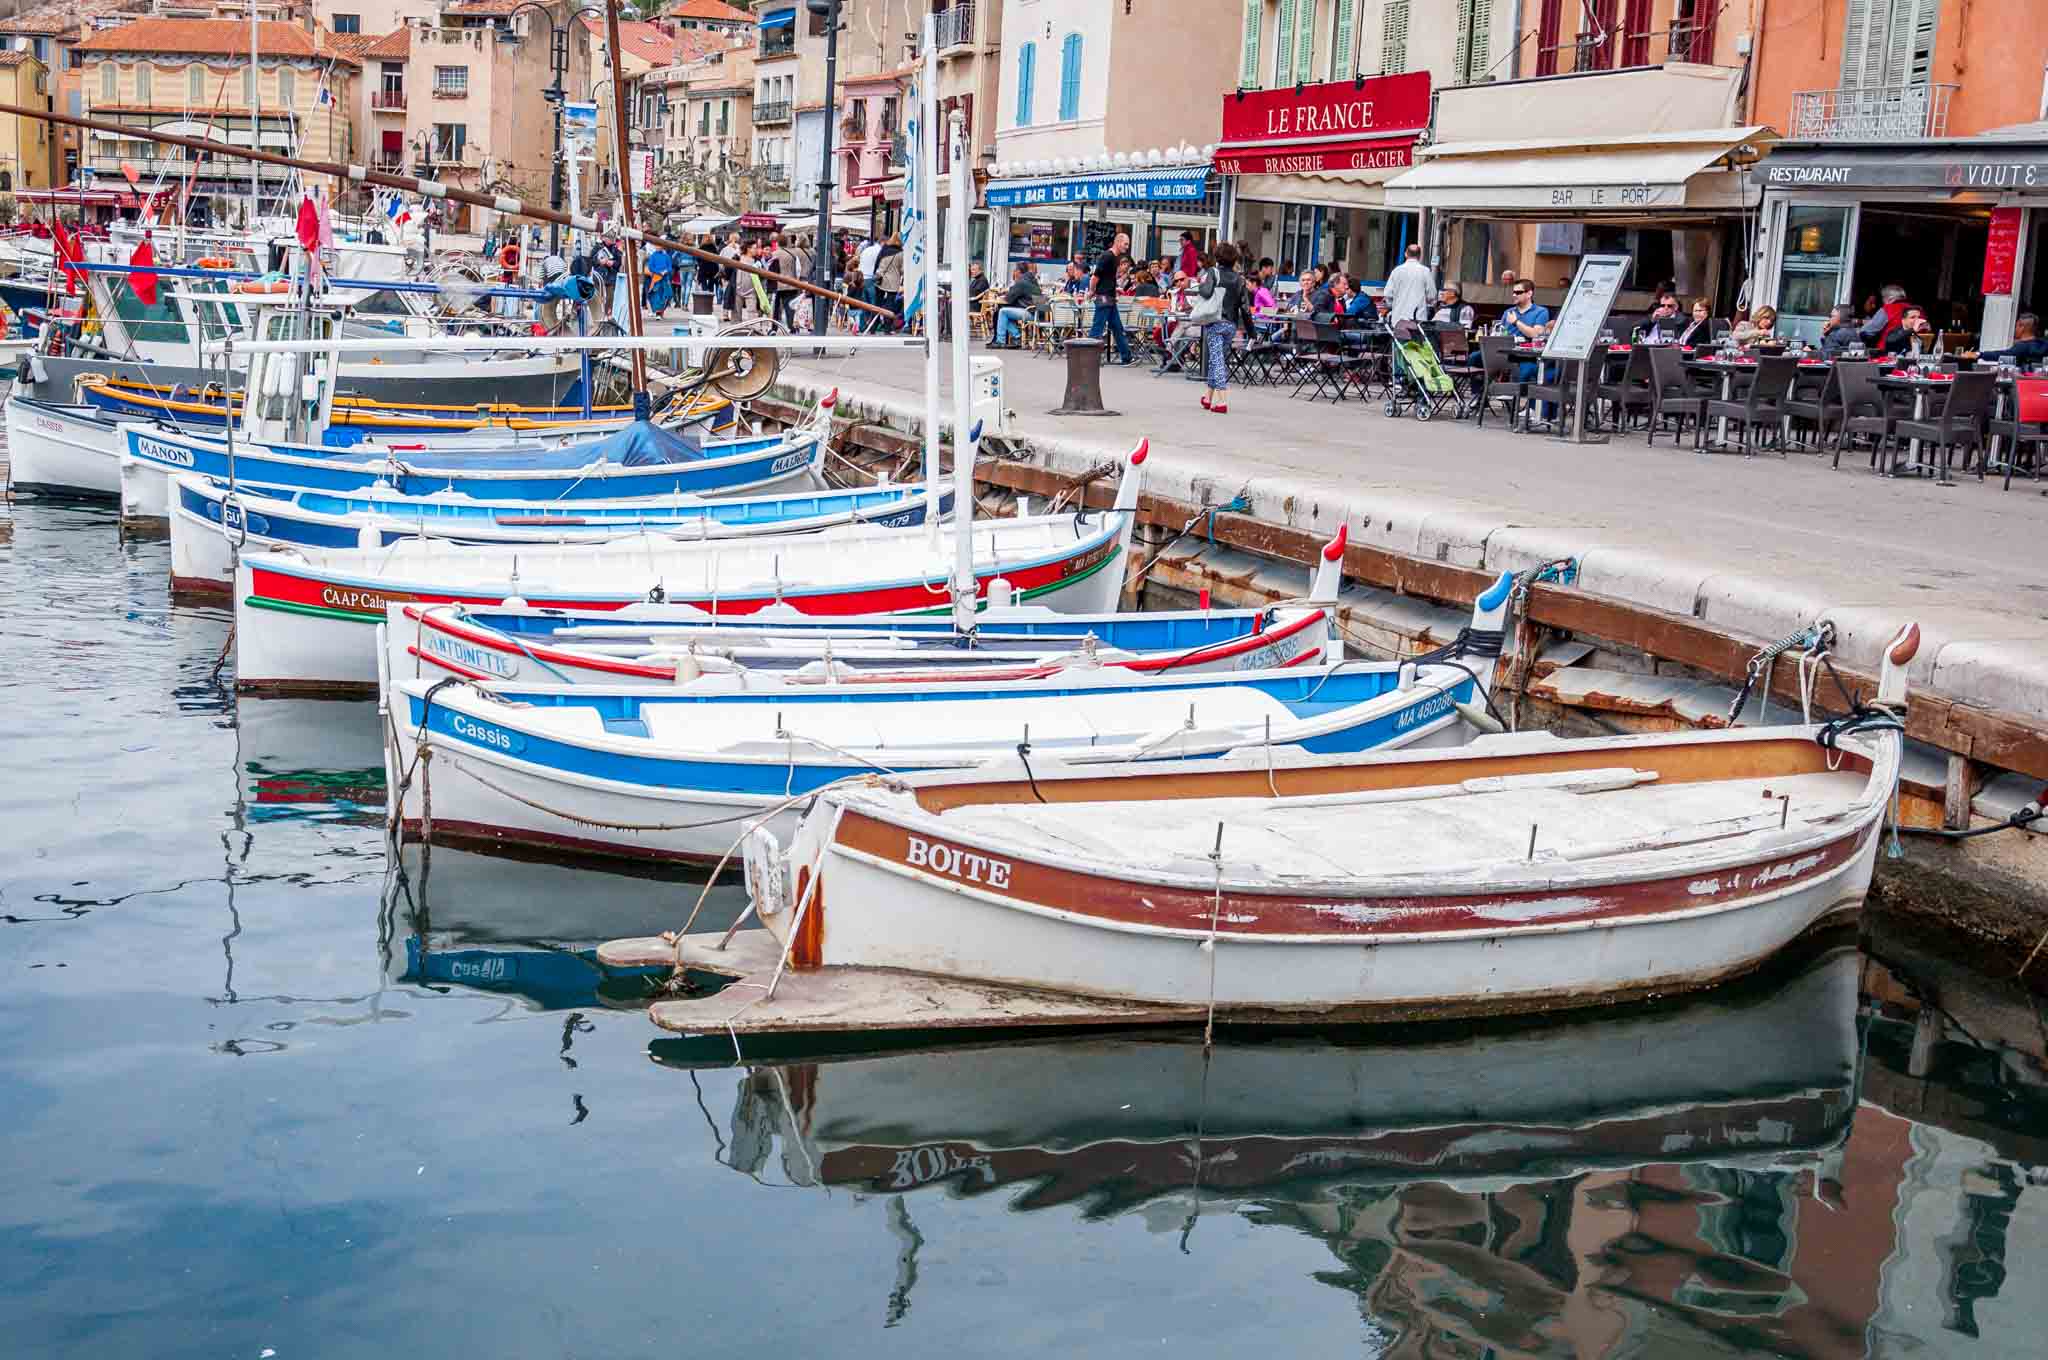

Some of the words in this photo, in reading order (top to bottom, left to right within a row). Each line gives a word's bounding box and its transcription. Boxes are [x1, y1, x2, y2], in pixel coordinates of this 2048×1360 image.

[1267, 108, 1290, 134] LE
[1296, 101, 1374, 132] FRANCE
[1220, 159, 1241, 174] BAR
[1264, 155, 1324, 173] BRASSERIE
[1351, 150, 1405, 169] GLACIER
[1769, 166, 1851, 182] RESTAURANT
[1968, 164, 2037, 187] VOUTE
[1025, 188, 1046, 203] BAR
[1053, 186, 1068, 200] DE
[1074, 184, 1089, 199] LA
[1097, 183, 1147, 199] MARINE
[1552, 189, 1573, 205] BAR
[1591, 189, 1605, 204] LE
[1621, 188, 1652, 204] PORT
[140, 439, 189, 464] MANON
[323, 588, 358, 607] CAAP
[360, 593, 388, 609] Cala
[1398, 707, 1415, 728] MA
[453, 715, 511, 749] Cassis
[905, 836, 1011, 889] BOITE
